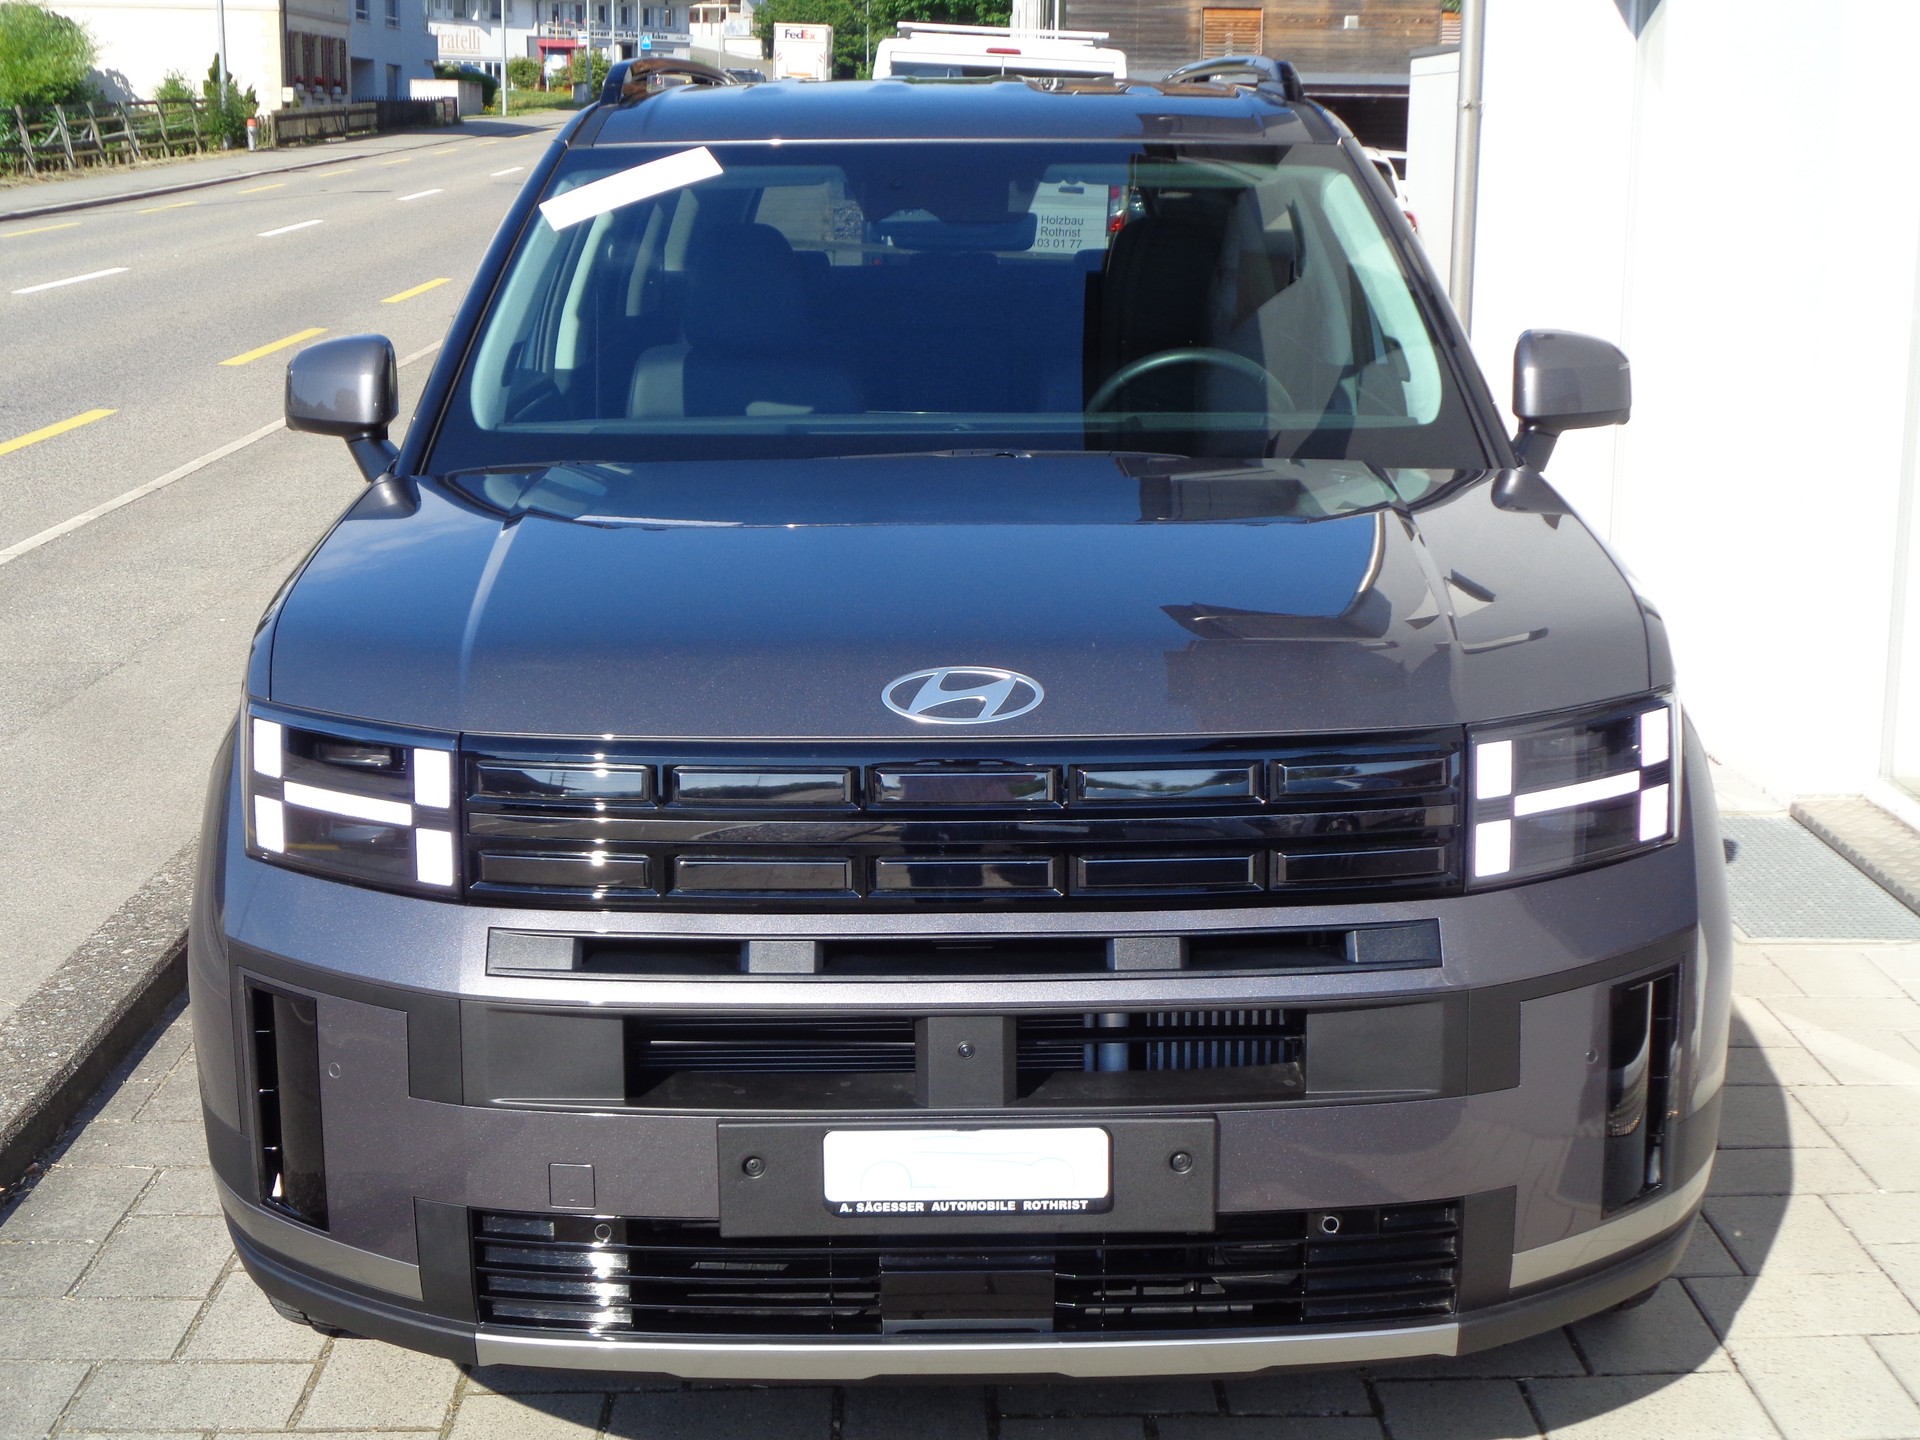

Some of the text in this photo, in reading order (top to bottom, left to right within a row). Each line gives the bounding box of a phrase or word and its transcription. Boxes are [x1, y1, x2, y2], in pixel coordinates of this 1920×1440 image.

[784, 29, 816, 40] FedEx
[1041, 215, 1084, 225] Holzbau
[1040, 226, 1081, 237] Rothrist
[1053, 238, 1065, 248] 01
[1070, 239, 1082, 248] 77
[839, 1199, 1089, 1213] A. SÄGESSER AUTOMOBILE ROTHRIST
